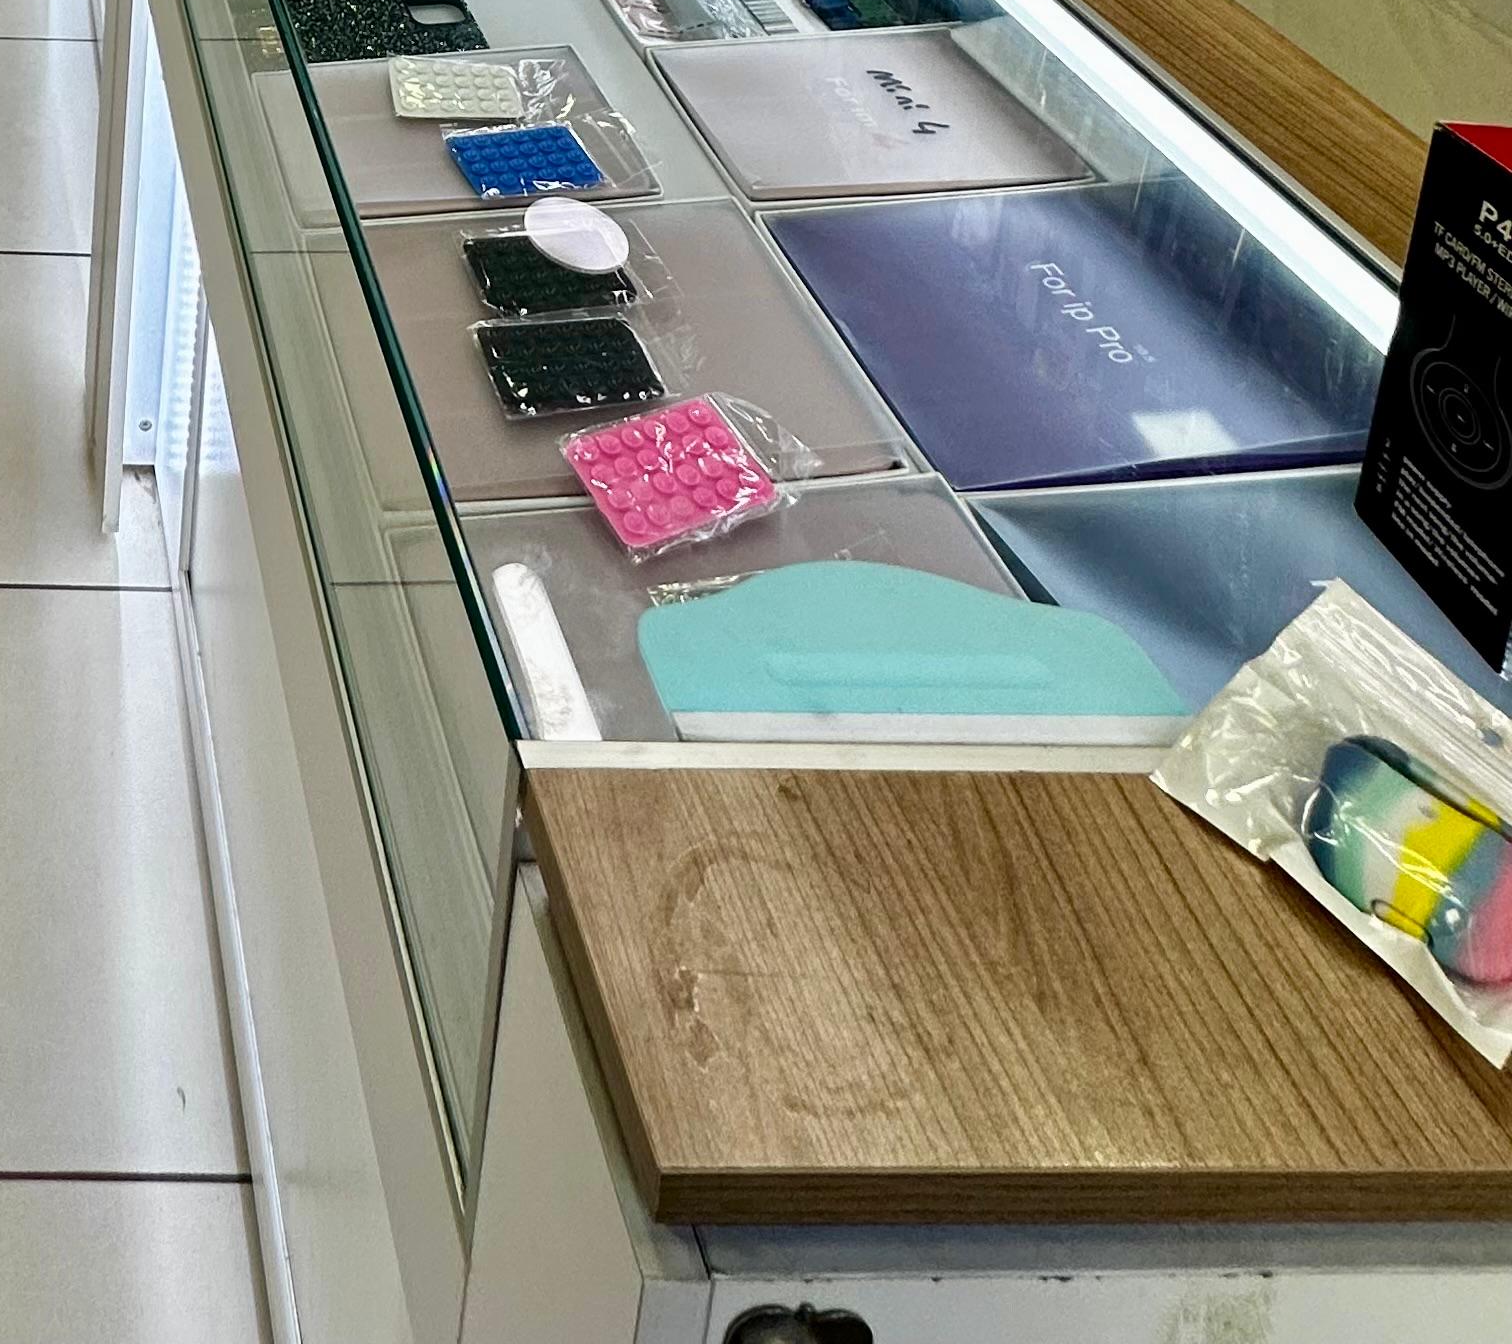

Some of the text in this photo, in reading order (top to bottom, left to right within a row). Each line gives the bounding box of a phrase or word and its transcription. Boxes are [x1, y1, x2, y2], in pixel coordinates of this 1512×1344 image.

[866, 69, 950, 135] Mini 4
[1435, 242, 1455, 269] MP3
[1456, 261, 1491, 299] PLAYER
[1030, 261, 1133, 363] For ip Pro
